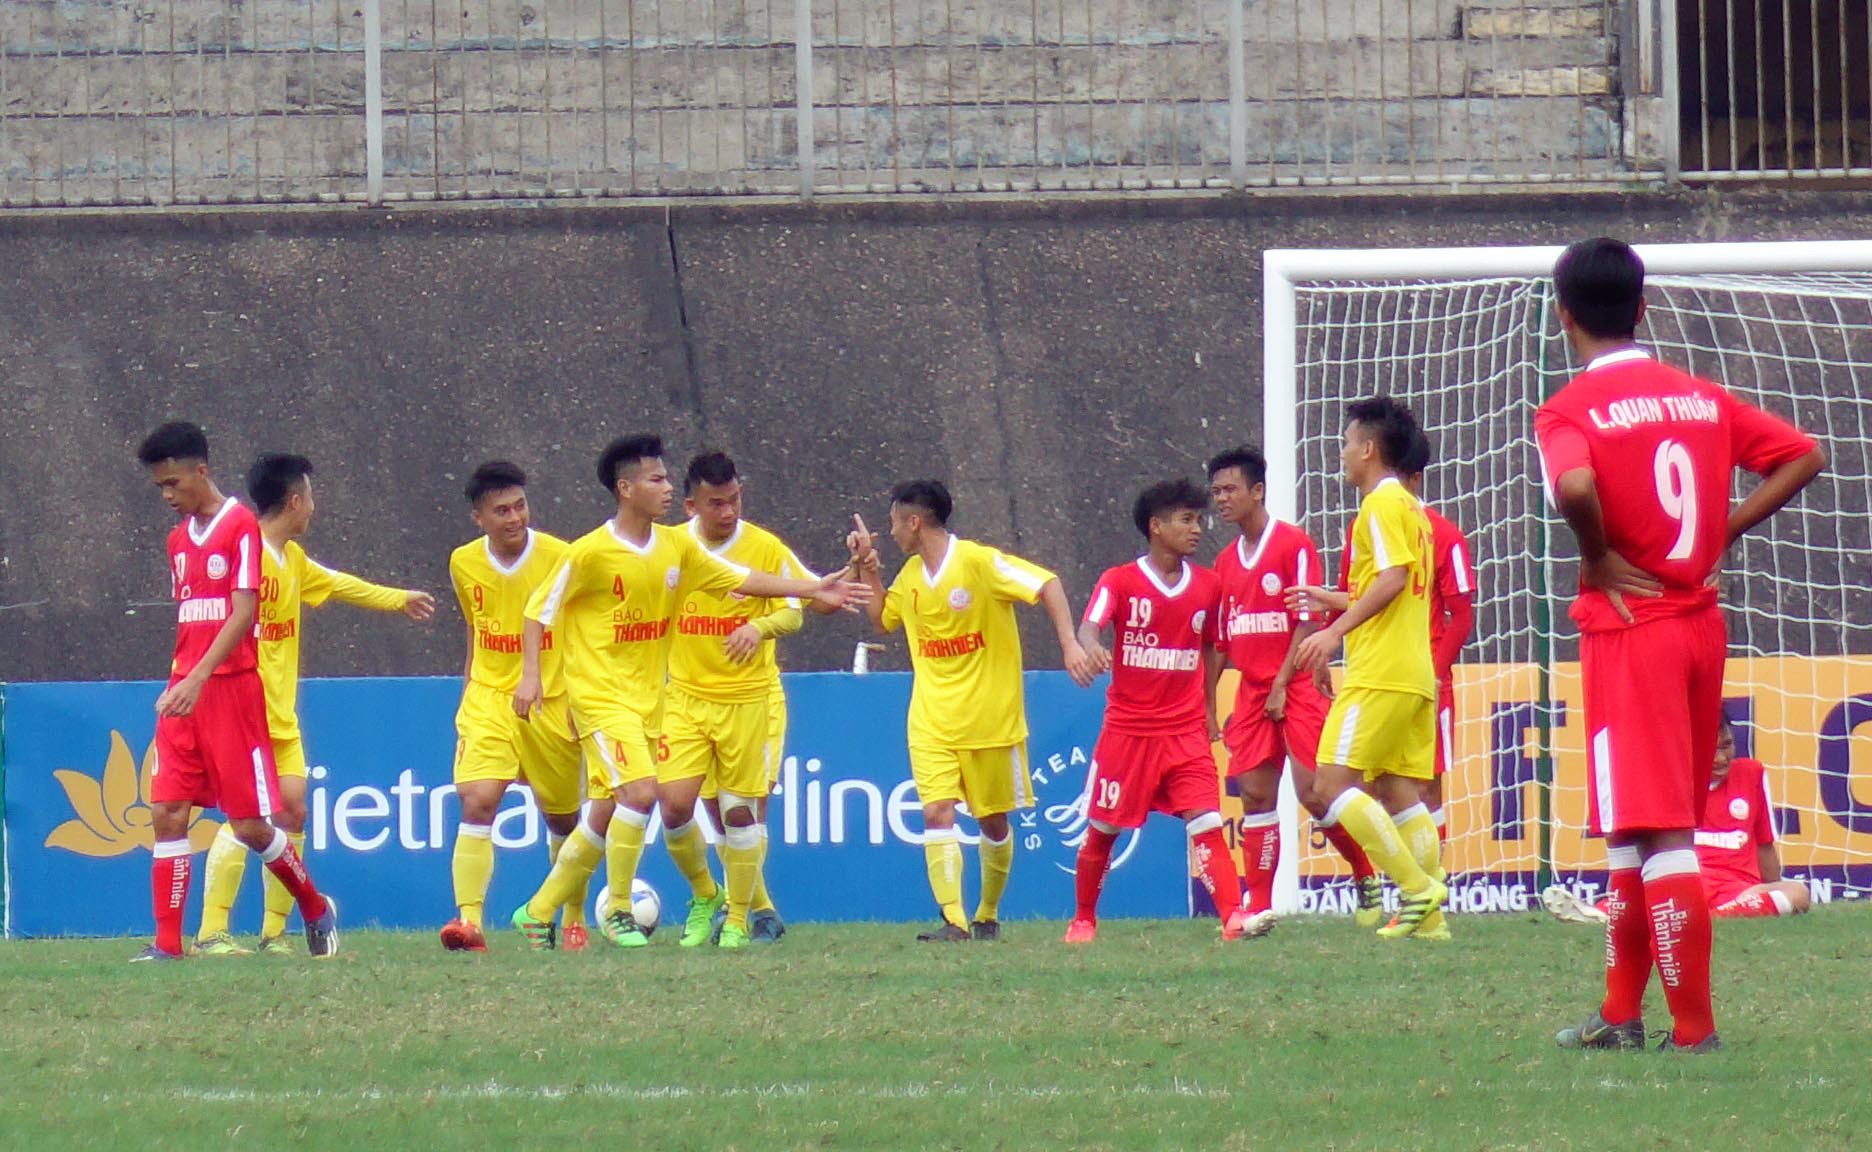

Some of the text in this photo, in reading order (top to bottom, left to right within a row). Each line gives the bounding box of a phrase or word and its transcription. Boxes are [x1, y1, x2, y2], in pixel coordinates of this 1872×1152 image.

[1653, 439, 1698, 560] 9
[473, 584, 483, 612] 9
[612, 575, 625, 601] 4
[1126, 597, 1152, 628] 19
[615, 740, 628, 767] 4
[657, 734, 670, 762] 5
[1096, 778, 1121, 810] 19
